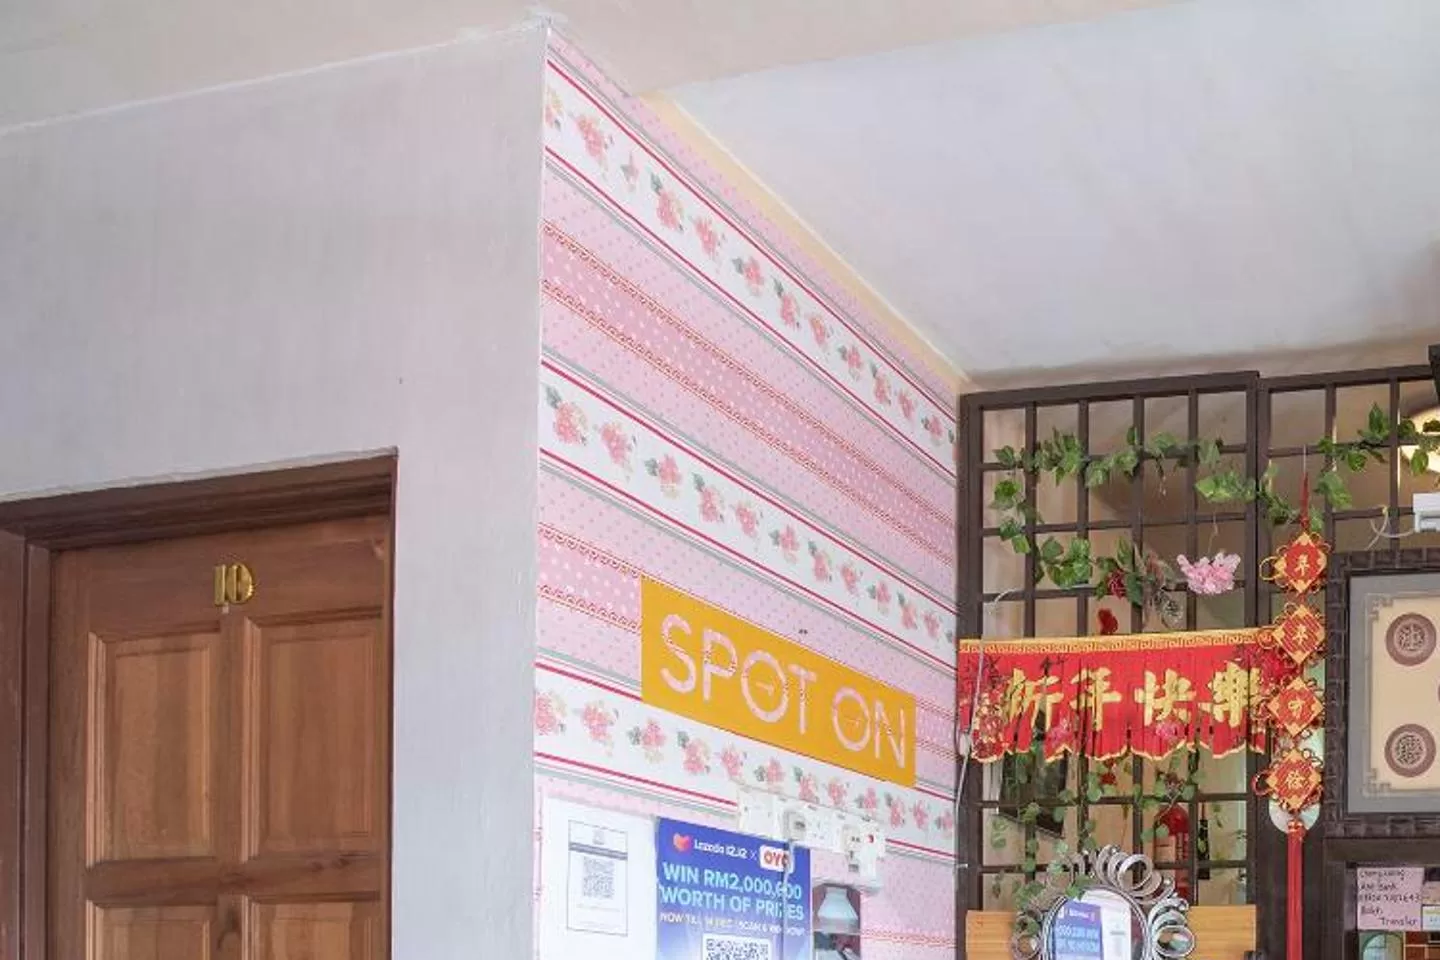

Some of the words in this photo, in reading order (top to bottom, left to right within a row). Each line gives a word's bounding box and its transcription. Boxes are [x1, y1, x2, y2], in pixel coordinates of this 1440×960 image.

[660, 613, 818, 735] SPOT
[832, 687, 905, 768] ON
[659, 885, 724, 910] WORTH
[730, 895, 751, 912] OF
[662, 862, 699, 884] WIN
[704, 869, 802, 900] RM2,000,000
